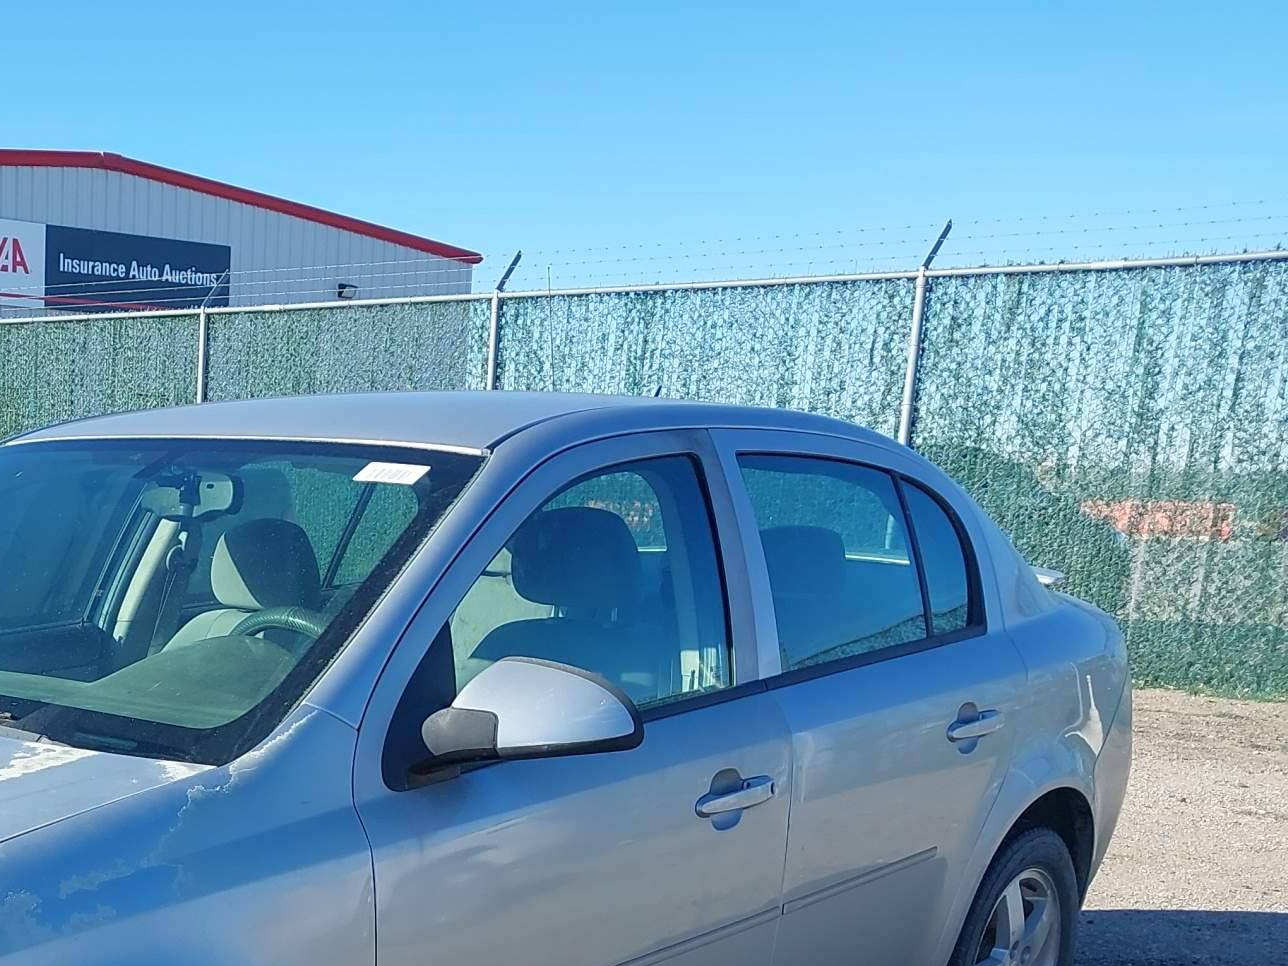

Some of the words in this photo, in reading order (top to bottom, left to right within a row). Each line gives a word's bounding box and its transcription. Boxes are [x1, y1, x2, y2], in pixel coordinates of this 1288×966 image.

[59, 252, 126, 278] Insurance
[129, 260, 159, 281] Auto
[162, 264, 217, 287] Auctions
